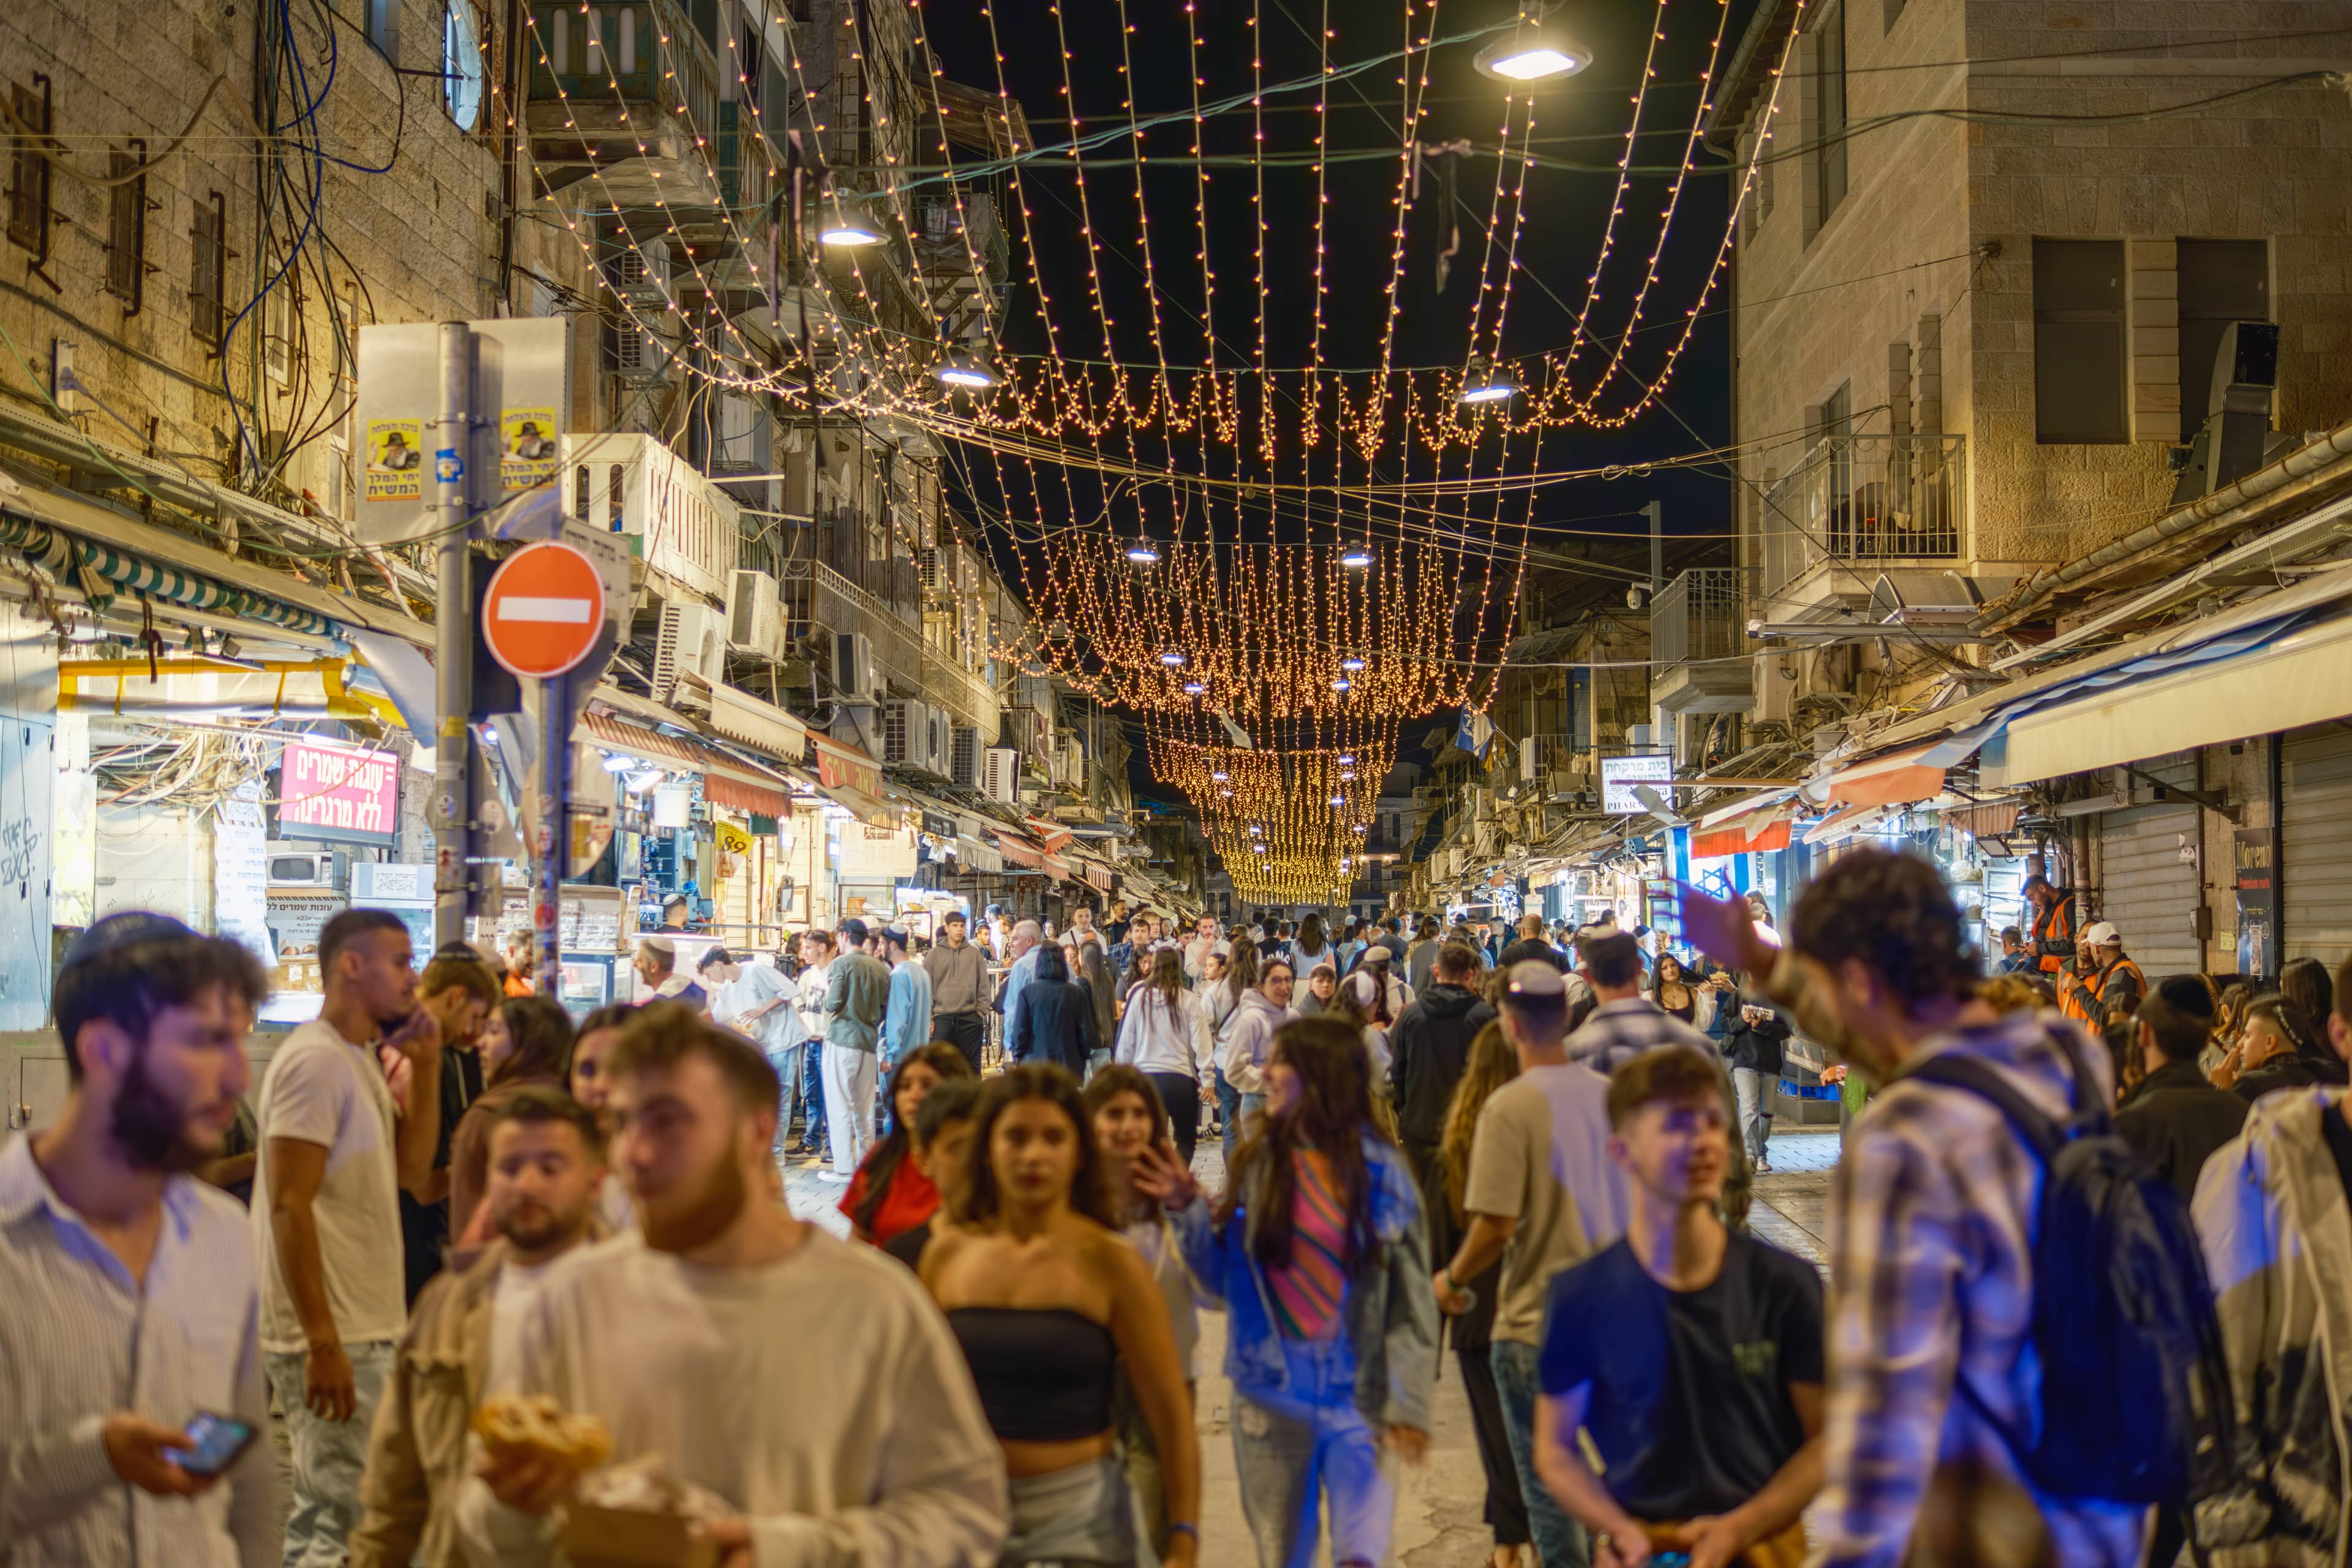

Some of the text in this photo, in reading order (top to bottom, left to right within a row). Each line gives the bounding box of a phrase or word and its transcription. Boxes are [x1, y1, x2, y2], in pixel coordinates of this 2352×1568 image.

[369, 474, 398, 483] המלך
[369, 484, 418, 496] המשיח
[296, 749, 384, 794] עוגות שמרים
[1605, 761, 1667, 774] בית מרקחת
[293, 792, 353, 827] מרגרינה
[355, 793, 382, 831] ללא
[722, 835, 747, 853] 89
[2236, 842, 2271, 869] Moreno
